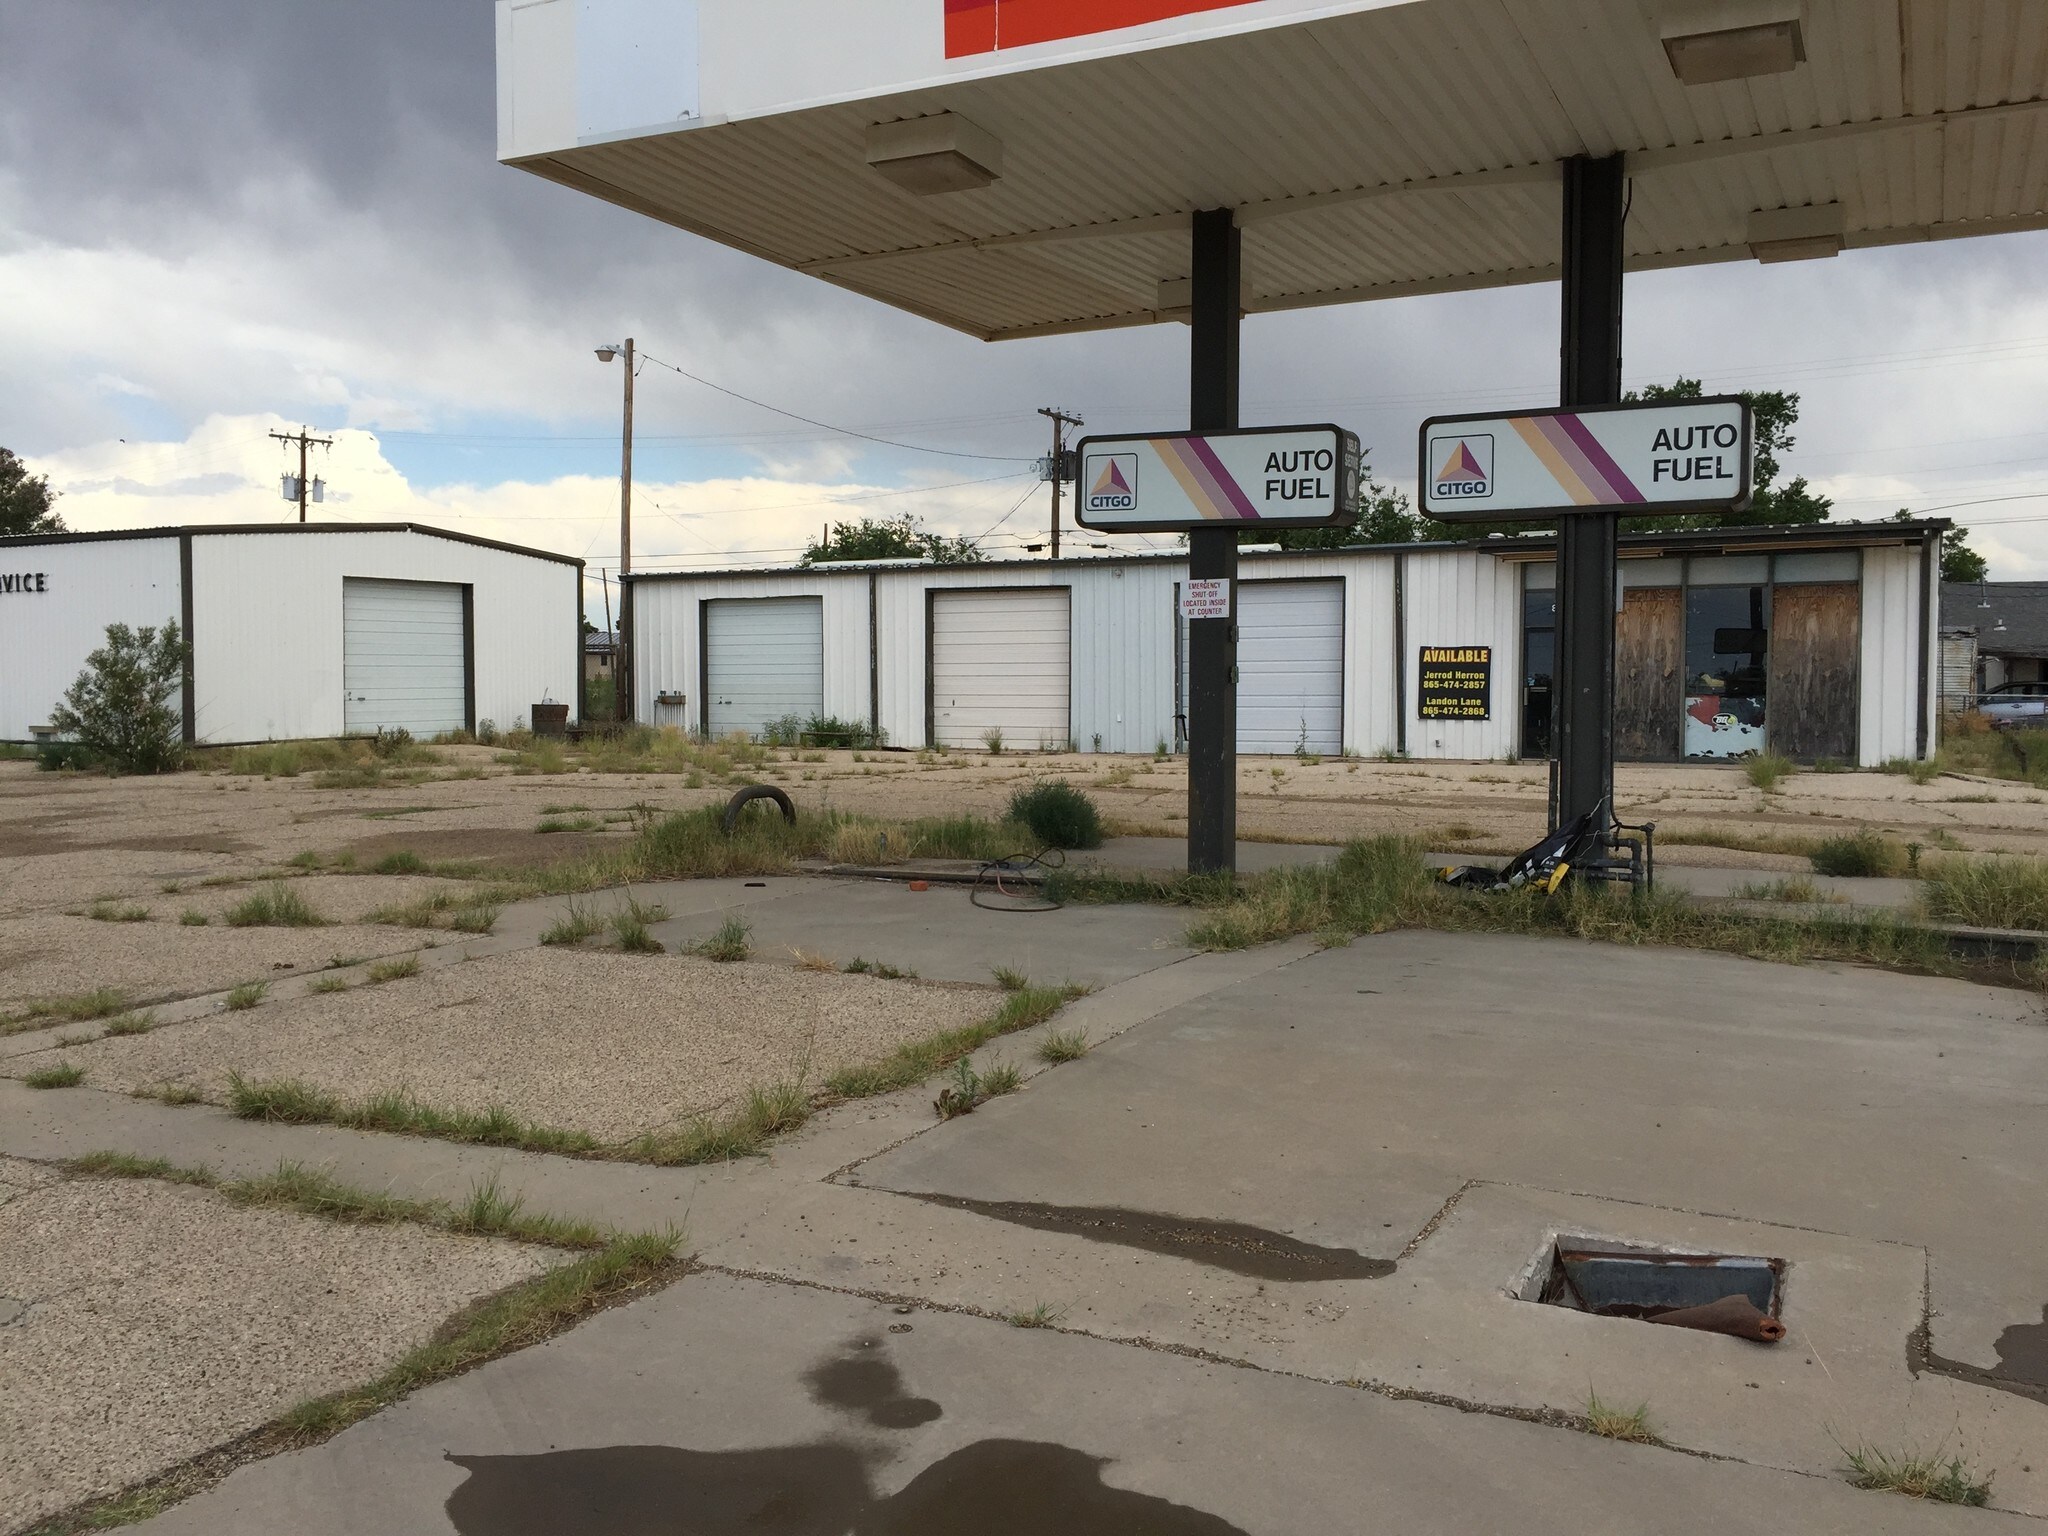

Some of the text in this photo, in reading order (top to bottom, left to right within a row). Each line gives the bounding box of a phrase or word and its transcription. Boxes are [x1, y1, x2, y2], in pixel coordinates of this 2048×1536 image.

[1651, 423, 1738, 452] AUTO
[1264, 449, 1333, 473] AUTO
[1653, 456, 1734, 483] FUEL
[1265, 478, 1330, 501] FUEL
[1437, 481, 1487, 496] CITGO
[1091, 495, 1132, 508] CITGO
[0, 572, 45, 593] VICE
[1183, 598, 1226, 607] LOCATED INSIDE
[1423, 650, 1488, 662] AVAILABLE
[1424, 671, 1485, 679] Jerrod Herron
[1426, 697, 1482, 706] Landon Lane
